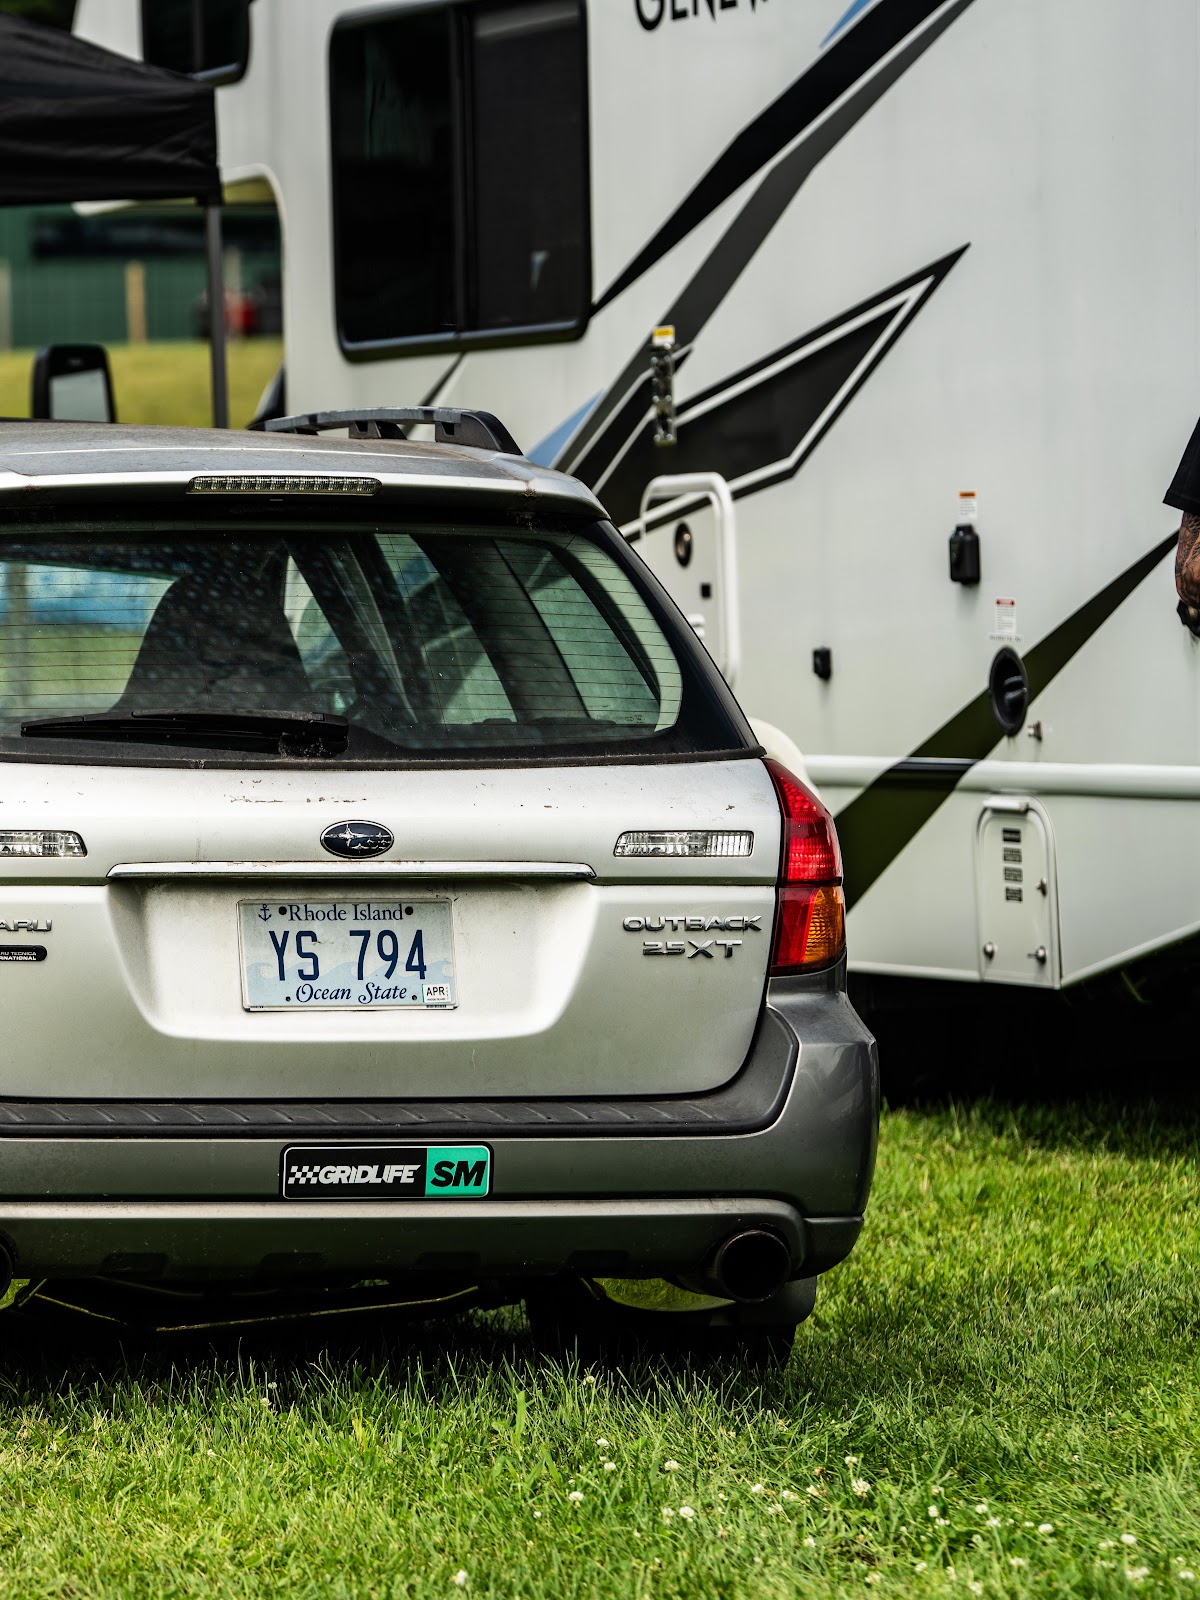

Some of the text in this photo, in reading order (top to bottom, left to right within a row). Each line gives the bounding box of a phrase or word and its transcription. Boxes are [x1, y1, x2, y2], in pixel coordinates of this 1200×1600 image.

[288, 903, 404, 921] Rhode Island
[623, 915, 762, 931] OUTBACK
[269, 929, 427, 981] YS 794
[296, 981, 407, 1004] Ocean State
[426, 986, 445, 996] APR
[318, 1160, 487, 1187] GRIDLIFE SM
